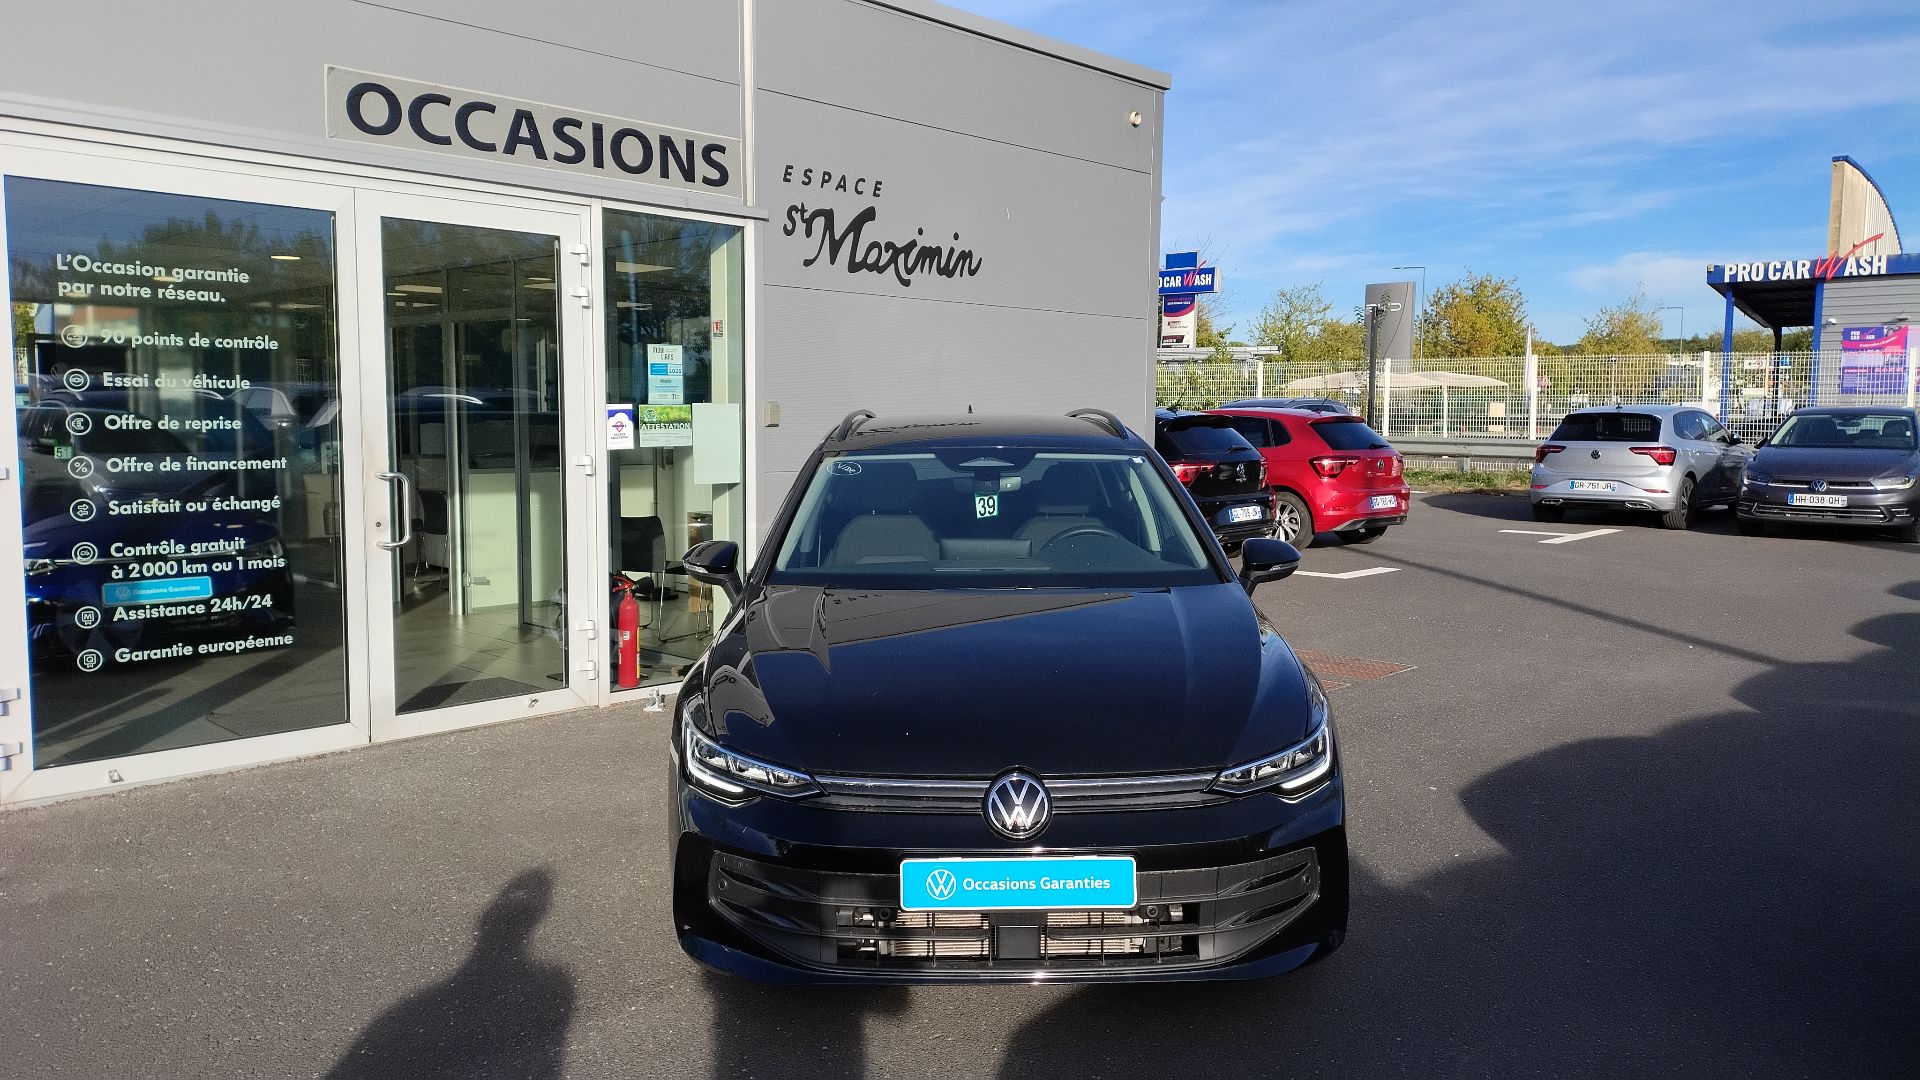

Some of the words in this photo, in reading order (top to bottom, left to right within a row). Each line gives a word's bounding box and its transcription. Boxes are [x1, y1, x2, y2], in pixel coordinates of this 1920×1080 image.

[346, 82, 730, 187] OCCASIONS
[782, 164, 883, 198] ESPACE
[802, 205, 983, 287] Maximin
[1723, 262, 1765, 282] PRO
[1768, 259, 1811, 280] CAR
[1814, 238, 1888, 280] WASH
[172, 266, 250, 284] garantie
[1163, 275, 1182, 288] CAR
[1183, 264, 1213, 288] WASH
[57, 280, 94, 298] par
[100, 283, 152, 299] notre
[158, 284, 227, 303] réseau.
[100, 330, 126, 345] 90
[131, 331, 184, 349] points
[189, 331, 211, 348] de
[214, 333, 279, 350] contrôle
[103, 371, 149, 388] Essai
[154, 371, 177, 389] du
[182, 371, 251, 390] véhicule
[104, 415, 153, 431] Offre
[157, 414, 180, 431] de
[185, 416, 242, 432] reprise
[106, 456, 154, 473] Offre
[159, 455, 182, 472] de
[186, 456, 287, 472] financement
[108, 496, 181, 516] Satisfait
[185, 499, 207, 513] ou
[212, 495, 281, 513] échangé
[977, 495, 996, 517] 39
[110, 539, 185, 558] Contrôle
[190, 537, 246, 556] gratuit
[111, 564, 124, 579] à
[182, 559, 208, 575] km
[212, 559, 233, 573] ou
[247, 554, 286, 571] mois
[112, 598, 206, 622] Assistance
[210, 592, 273, 614] 24h/24
[115, 641, 194, 664] Garantie
[198, 632, 294, 656] européenne
[963, 877, 1036, 891] Occasions
[1040, 876, 1111, 890] Garanties
